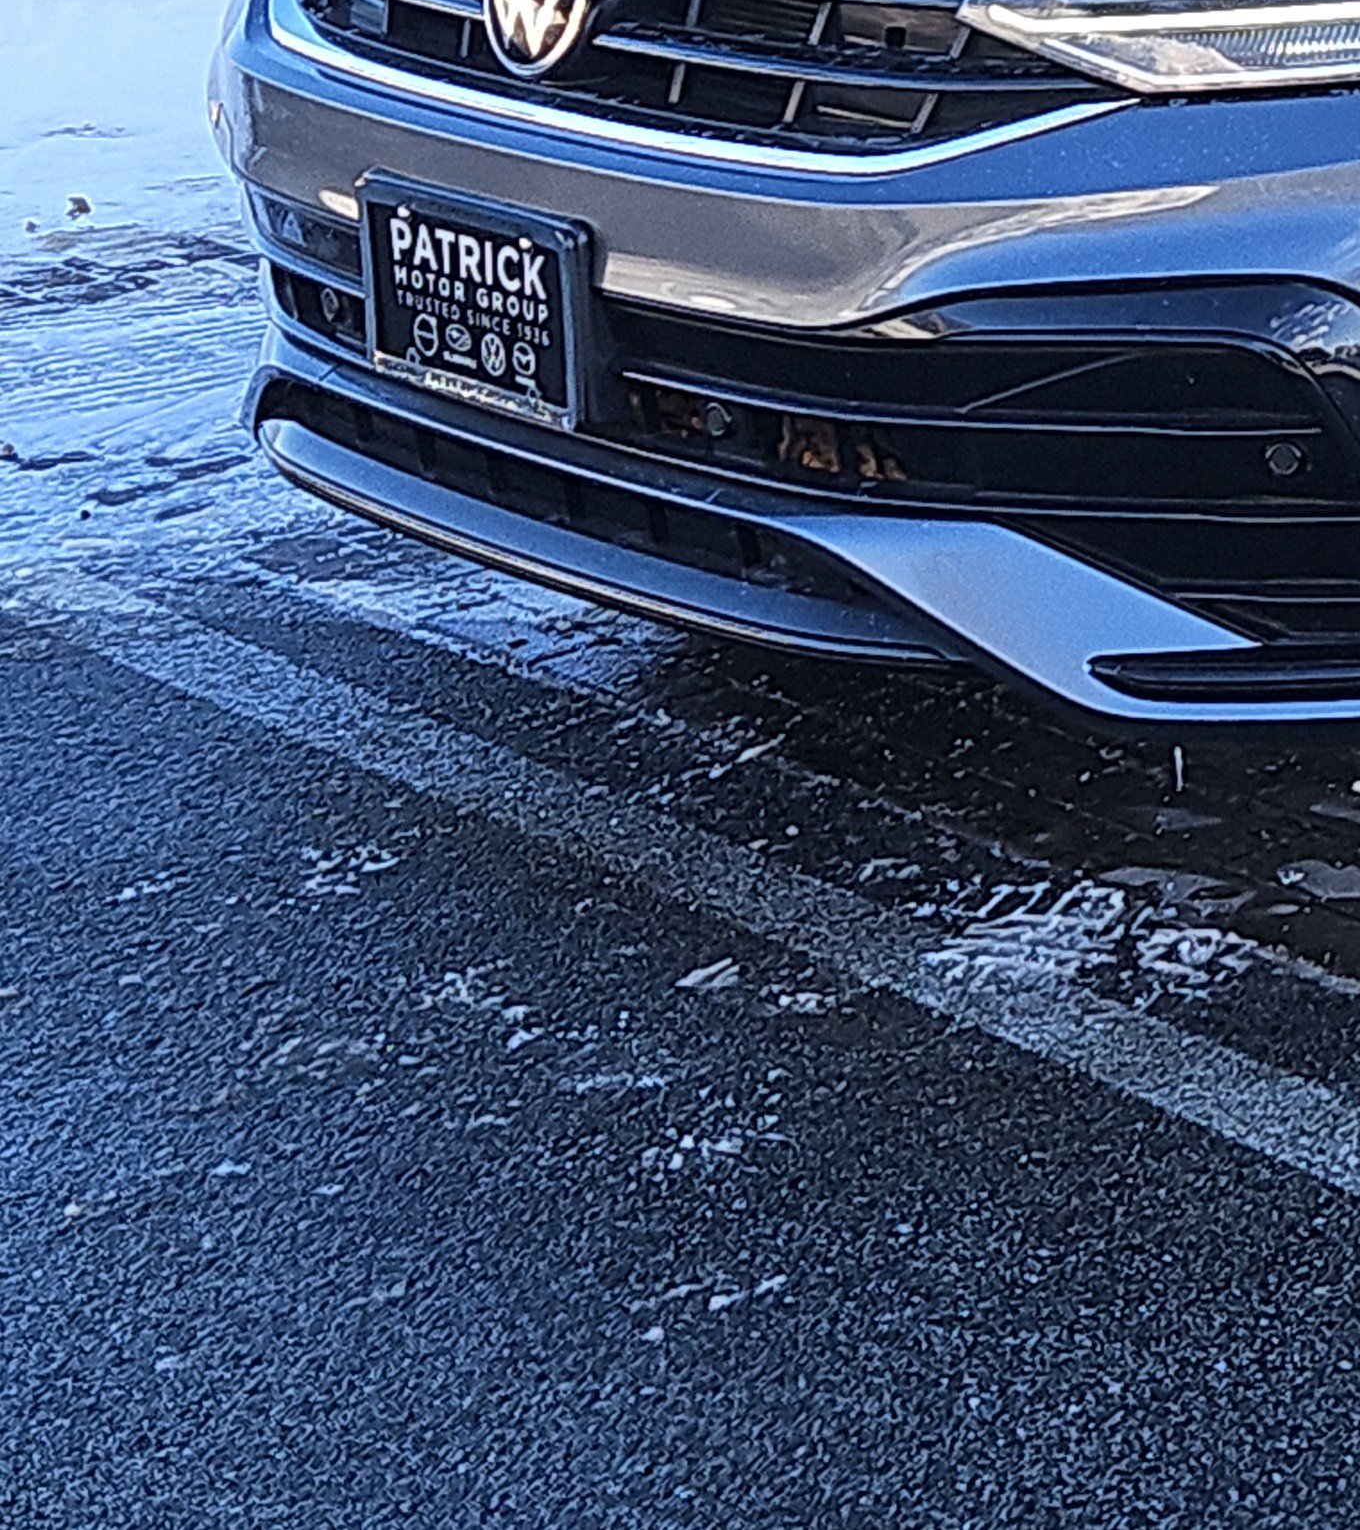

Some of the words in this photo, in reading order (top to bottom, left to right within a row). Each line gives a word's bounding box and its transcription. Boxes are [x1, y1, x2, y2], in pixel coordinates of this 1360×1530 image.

[390, 218, 548, 300] PATRICK
[393, 264, 466, 303] MOTOR
[476, 287, 549, 325] GROUP
[396, 289, 461, 321] TRUSTED
[466, 309, 511, 336] SINCE
